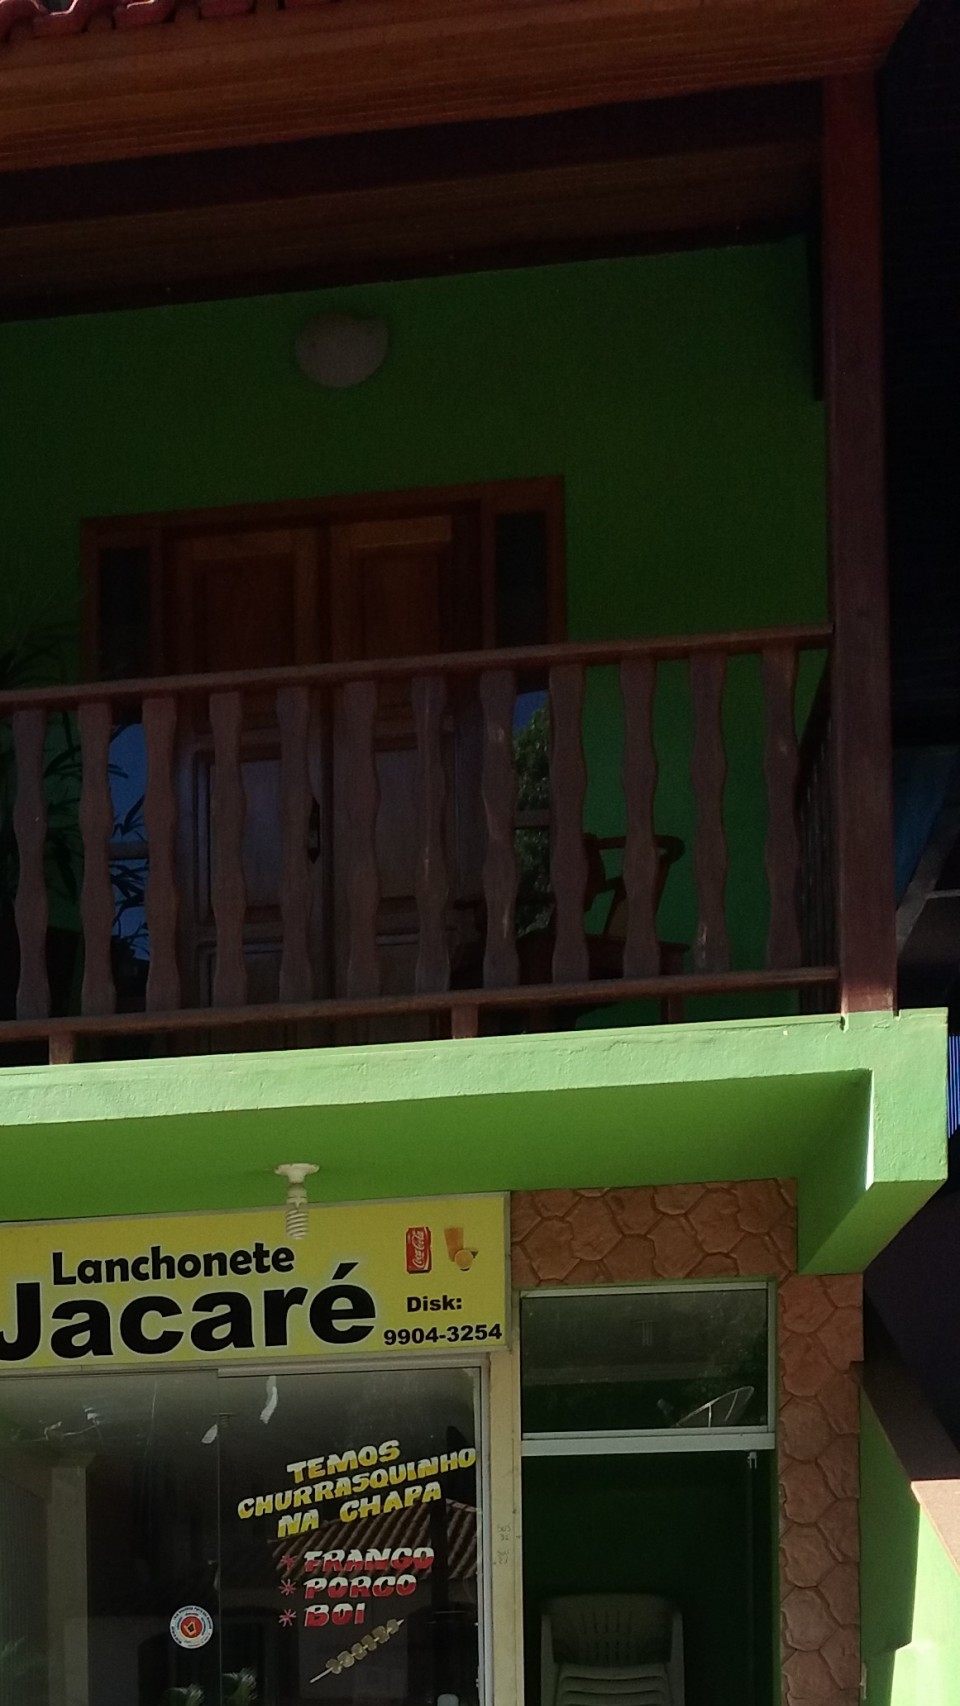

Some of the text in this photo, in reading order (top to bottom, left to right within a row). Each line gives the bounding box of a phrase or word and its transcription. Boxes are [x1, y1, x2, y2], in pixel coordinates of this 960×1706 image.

[51, 1241, 295, 1286] Lanchonete
[406, 1293, 463, 1314] Disk:
[383, 1322, 502, 1347] 9904-3254
[287, 1439, 401, 1485] TEMOS
[237, 1447, 478, 1520] CHURRASQUINHO
[277, 1481, 442, 1539] NA CHAPA
[303, 1547, 435, 1573] FRANGO
[304, 1574, 418, 1600] PORCO
[304, 1602, 366, 1628] BOI
